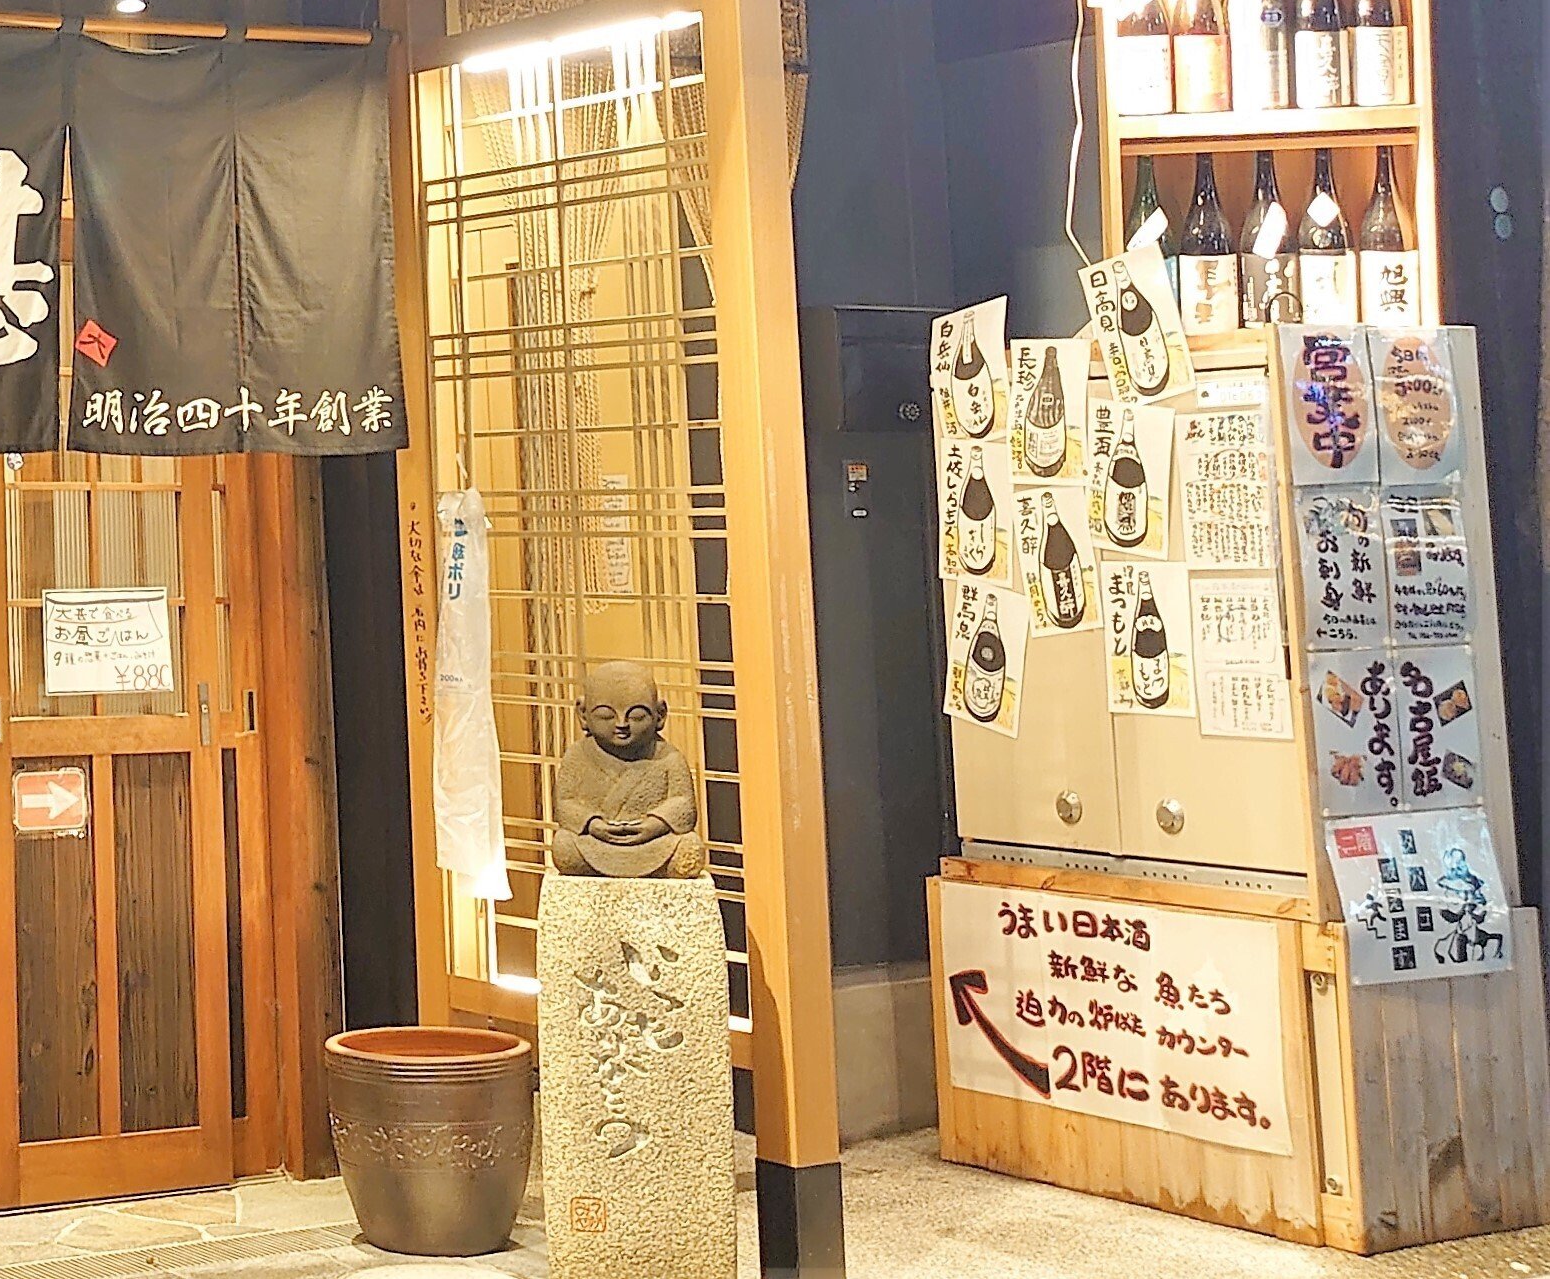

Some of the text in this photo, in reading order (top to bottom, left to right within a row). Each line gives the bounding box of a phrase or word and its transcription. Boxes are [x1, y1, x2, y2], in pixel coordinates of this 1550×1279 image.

[1090, 270, 1116, 333] 日高見
[936, 320, 954, 373] 白岳仙
[1016, 347, 1037, 392] 長珍
[82, 386, 394, 440] 明治四十年創業
[1017, 496, 1039, 556] 喜久酔
[54, 625, 150, 647] お昼ごはん
[955, 585, 979, 641] 群馬泉
[1108, 573, 1127, 657] まつもと
[113, 663, 171, 691] ¥880
[1360, 660, 1399, 807] あります。
[1400, 662, 1443, 797] 名古屋飯
[997, 902, 1151, 952] うまい日本酒
[1047, 950, 1232, 1016] 新鮮な 魚たち
[1156, 1025, 1250, 1059] カウンター
[1051, 1045, 1150, 1102] 2階に
